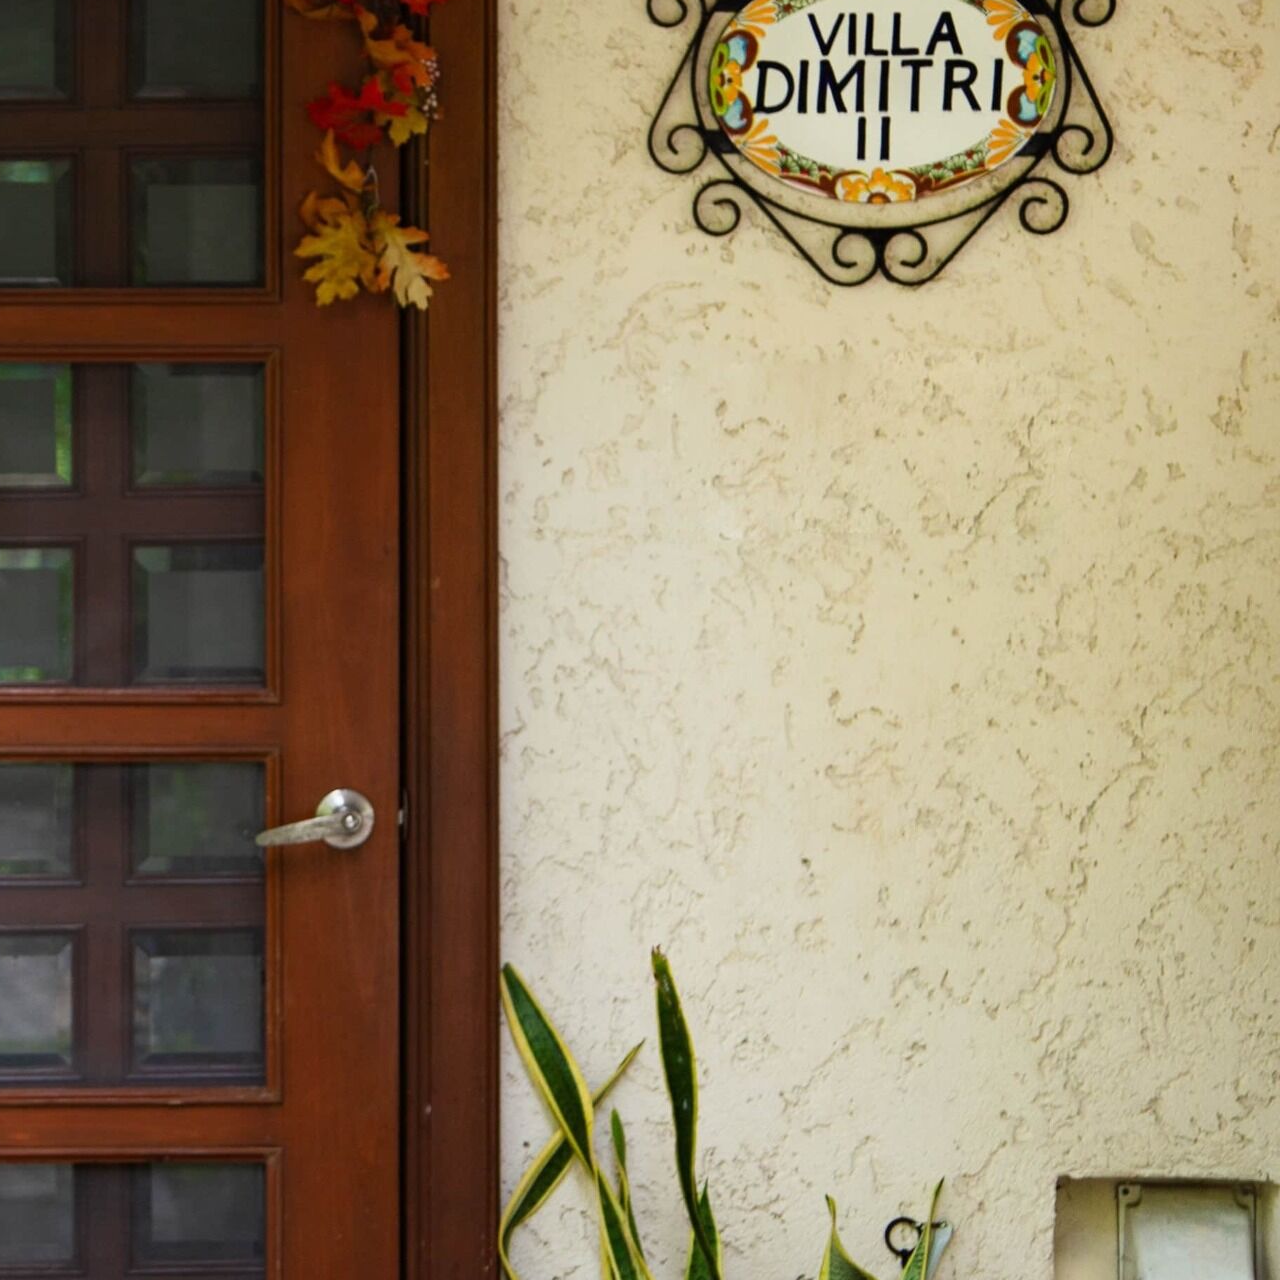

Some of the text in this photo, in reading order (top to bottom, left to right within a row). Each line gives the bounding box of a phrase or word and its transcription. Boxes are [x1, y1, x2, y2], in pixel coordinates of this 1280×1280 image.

[807, 11, 964, 57] VILLA
[753, 58, 1004, 115] DIMITRI
[856, 116, 891, 162] II
